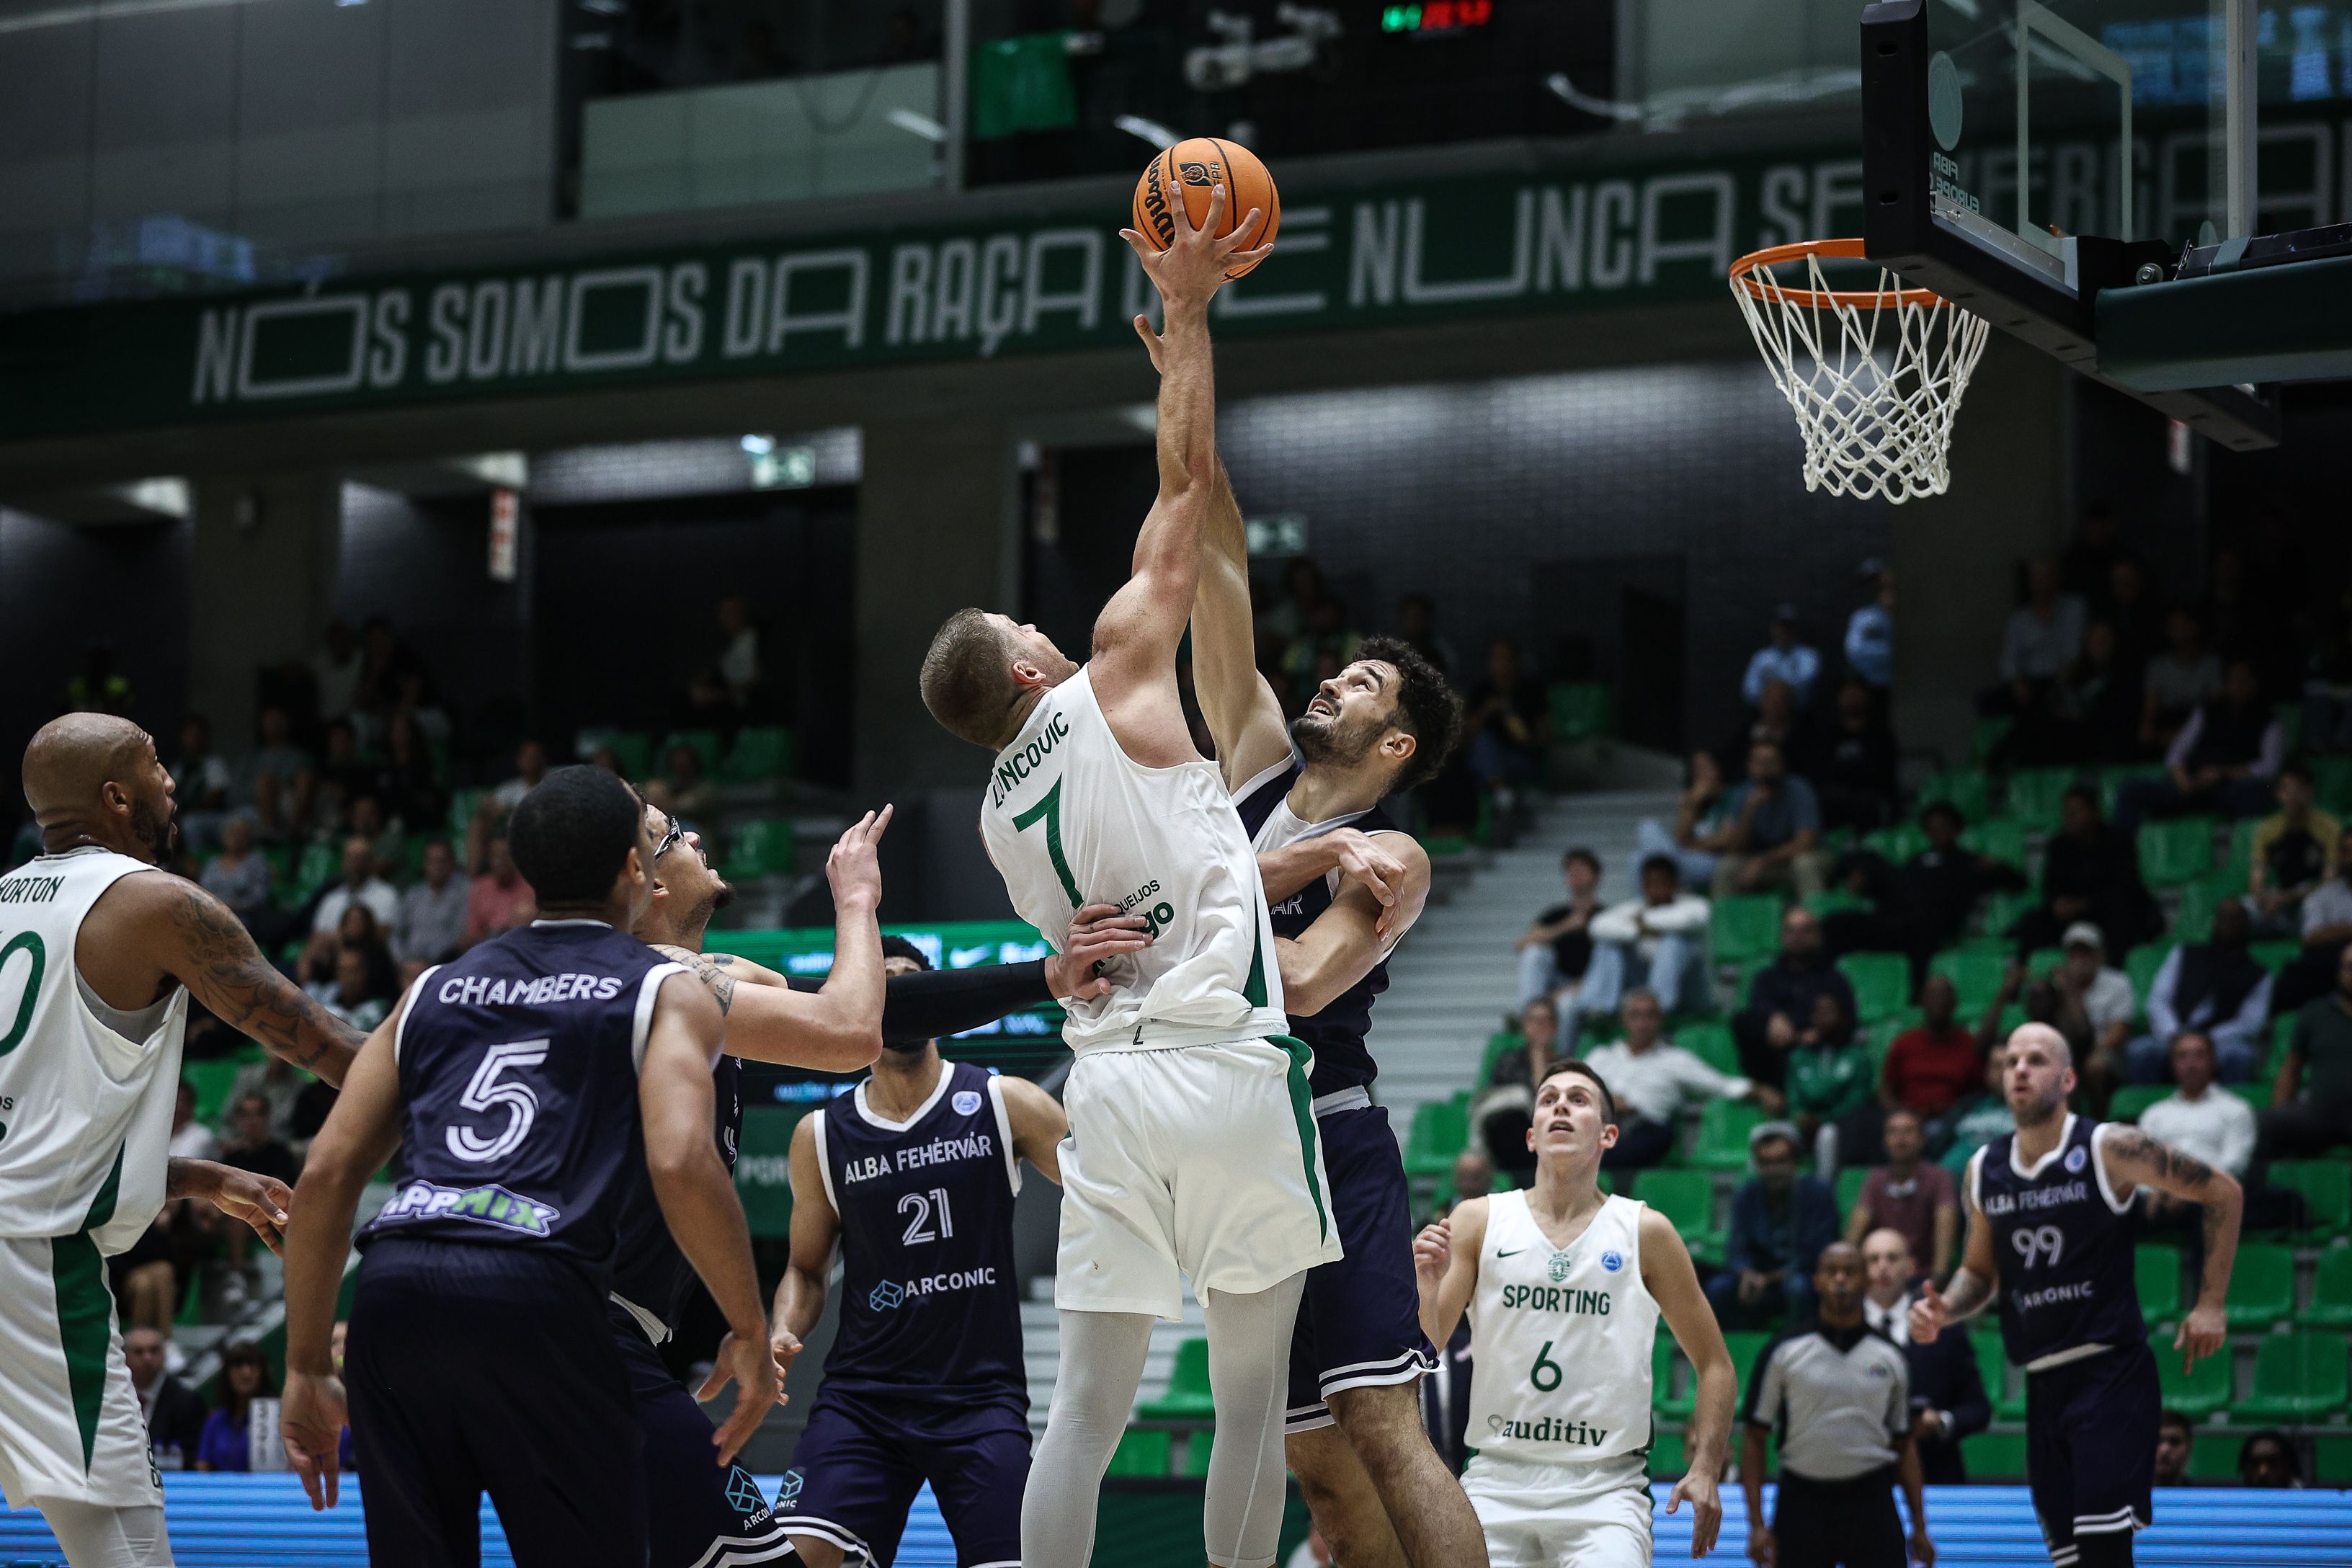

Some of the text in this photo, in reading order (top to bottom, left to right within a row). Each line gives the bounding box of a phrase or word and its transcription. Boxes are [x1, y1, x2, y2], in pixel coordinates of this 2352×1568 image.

[1146, 155, 1175, 245] Wilson
[192, 280, 410, 403] NÓS
[425, 262, 707, 383] SOMOS
[725, 249, 868, 358] DA
[885, 227, 1105, 357] RAÇA
[1348, 171, 1737, 306] NUNCA
[1012, 771, 1084, 909] 7
[437, 973, 623, 1006] CHAMBERS
[445, 1038, 551, 1164] 5
[845, 1131, 993, 1185] ALBA FEHÉRVÁR
[896, 1187, 953, 1246] 21
[2011, 1225, 2063, 1270] 99
[905, 1267, 997, 1298] ARCONIC
[1502, 1284, 1611, 1316] SPORTING
[1530, 1340, 1563, 1392] 6
[1502, 1416, 1608, 1447] auditiv
